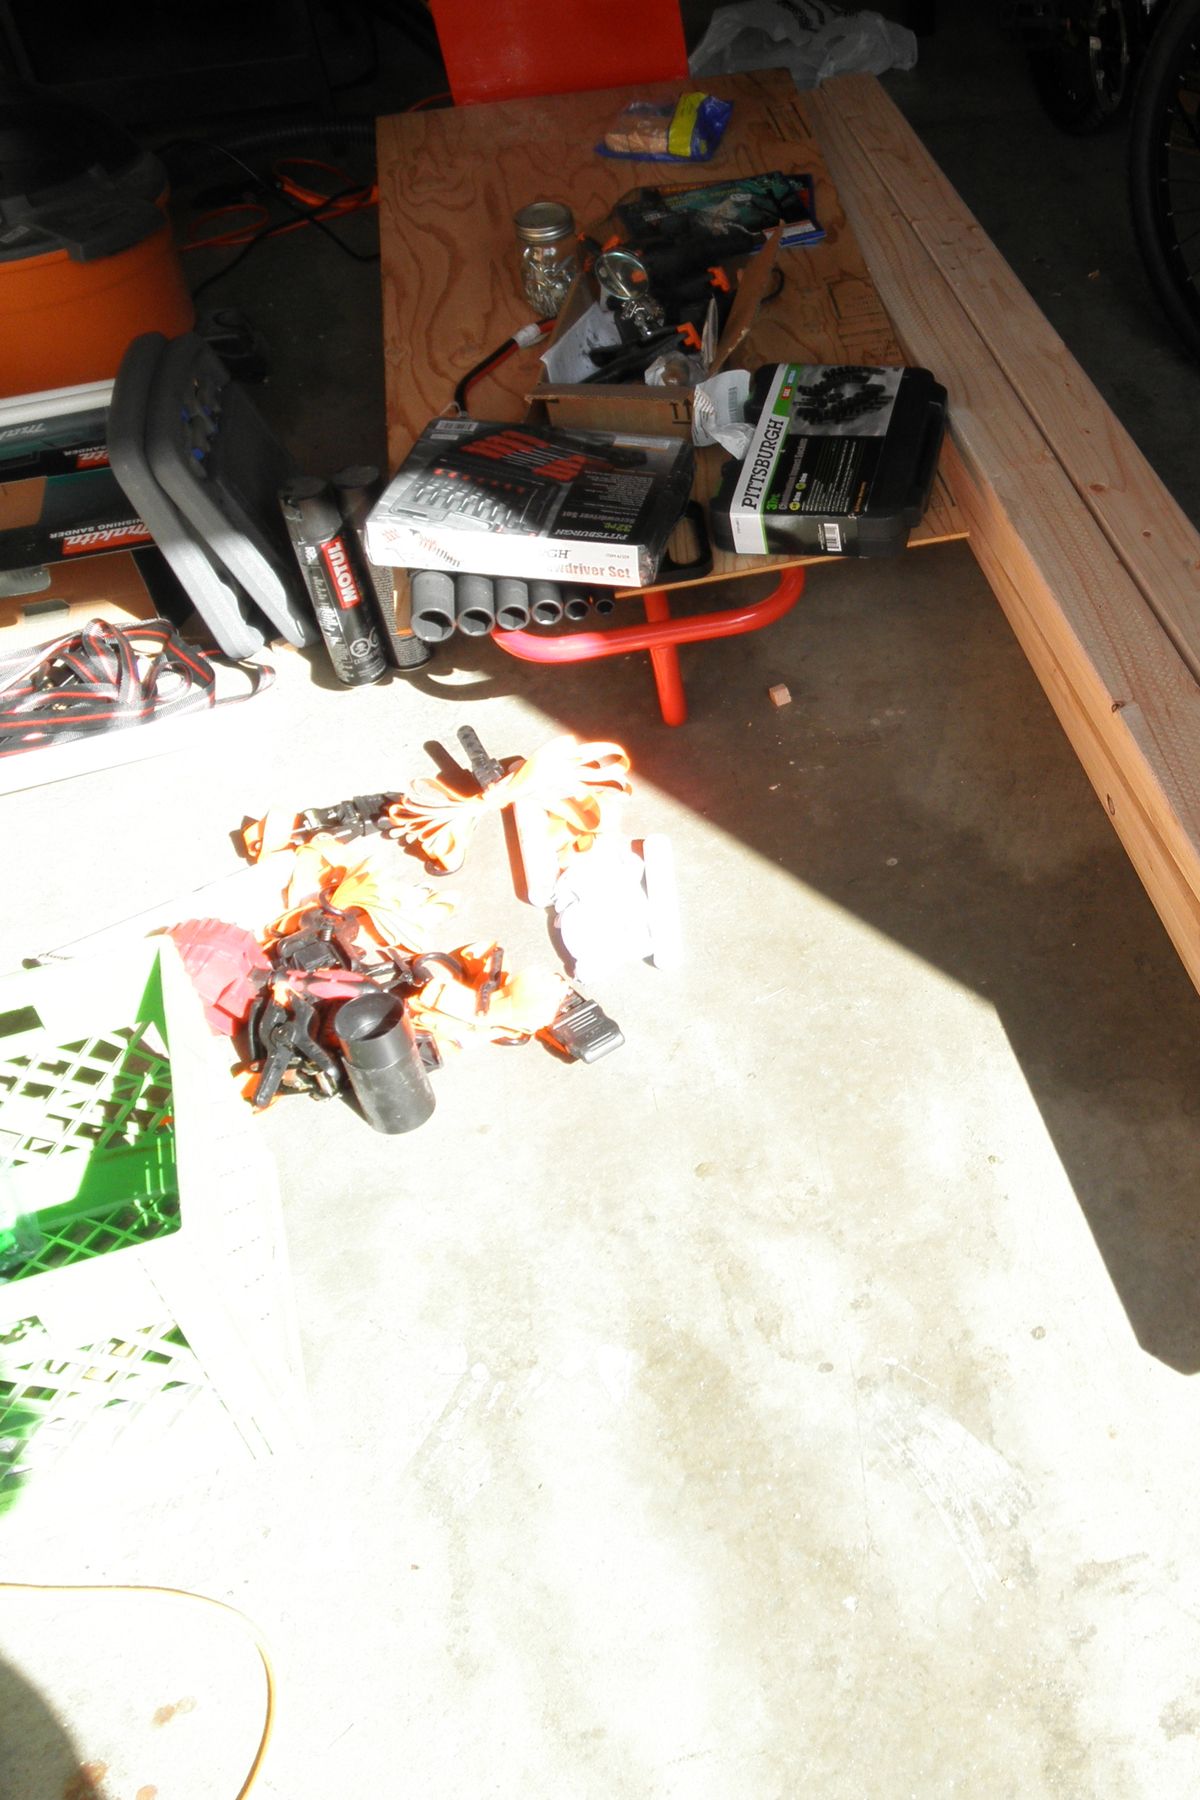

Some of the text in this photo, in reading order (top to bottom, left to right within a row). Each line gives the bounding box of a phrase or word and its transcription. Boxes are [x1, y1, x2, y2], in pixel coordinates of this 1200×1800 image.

[741, 418, 784, 510] PITTSBURGH
[49, 519, 143, 539] NISHING SANDER
[64, 523, 150, 545] makita
[554, 528, 629, 540] PITTSBURGH
[327, 542, 358, 603] MOTUL
